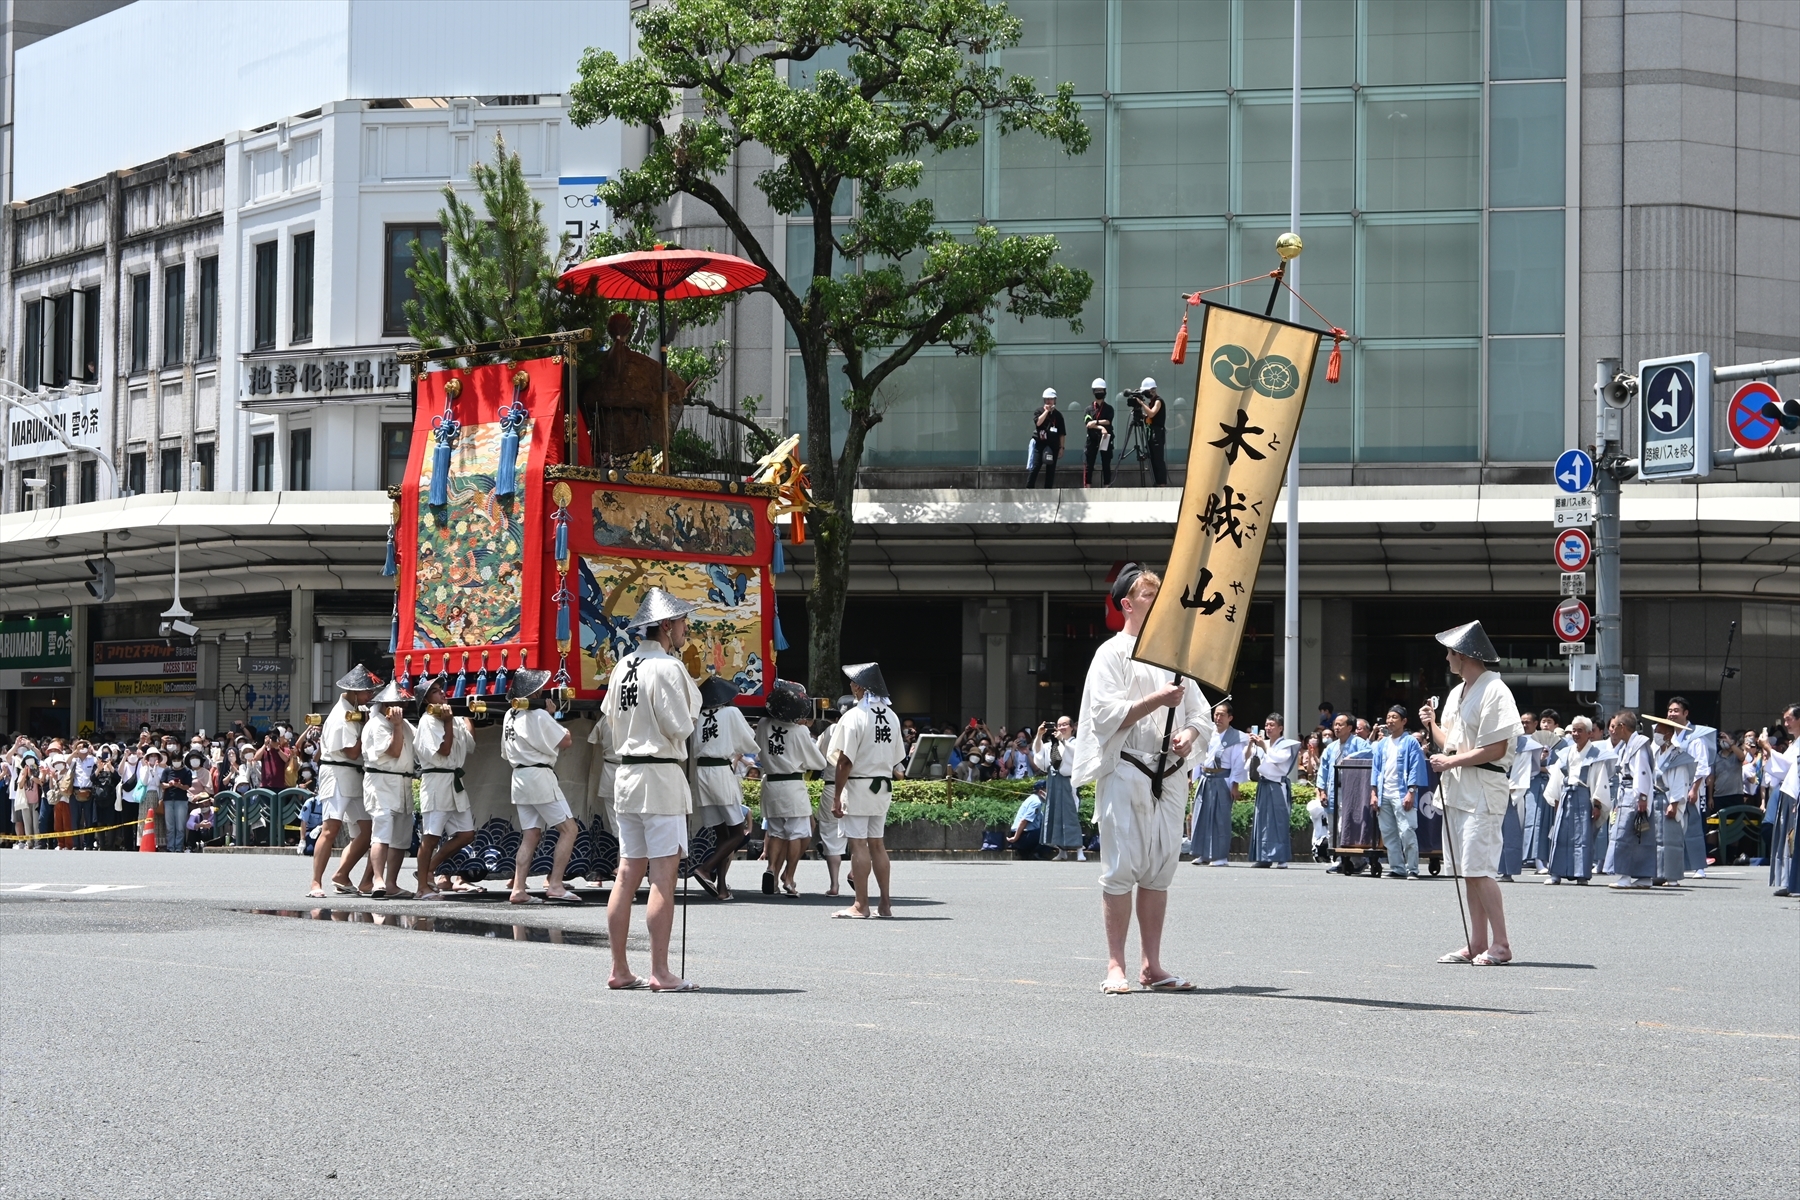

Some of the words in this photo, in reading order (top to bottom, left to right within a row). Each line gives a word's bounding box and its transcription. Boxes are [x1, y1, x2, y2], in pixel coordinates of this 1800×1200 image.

[248, 358, 400, 396] 池善化粧品店
[71, 407, 99, 437] 雲の茶
[1645, 443, 1694, 462] 路線バスを除く
[1180, 408, 1267, 616] 木賊山
[1555, 496, 1591, 508] 路線バスを除く
[107, 644, 175, 659] アクセスチケット
[162, 662, 181, 673] ACCESS
[181, 661, 197, 672] TICKET
[252, 664, 281, 672] コンタクト
[114, 681, 133, 695] Money
[163, 683, 171, 692] No
[171, 682, 196, 692] Commission
[619, 657, 646, 711] 木賊
[702, 708, 720, 743] 木賊
[768, 725, 789, 755] 木賊
[871, 707, 892, 744] 木賊
